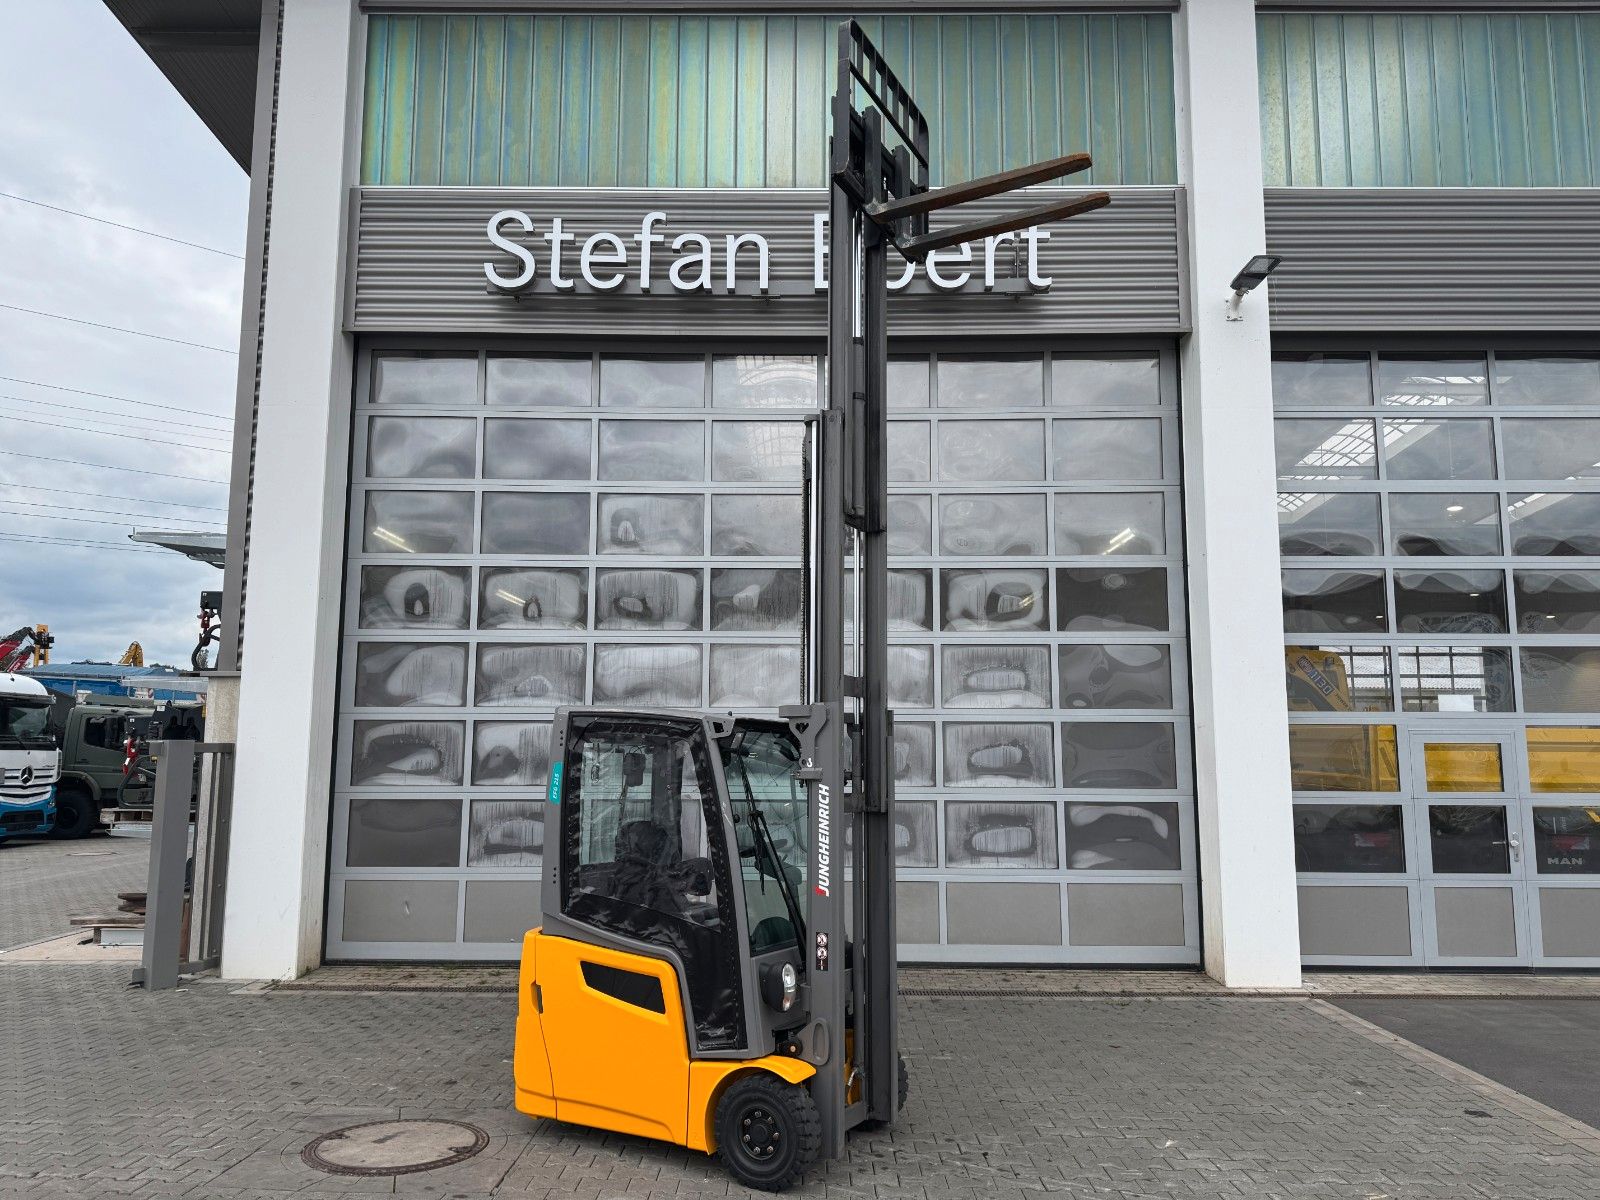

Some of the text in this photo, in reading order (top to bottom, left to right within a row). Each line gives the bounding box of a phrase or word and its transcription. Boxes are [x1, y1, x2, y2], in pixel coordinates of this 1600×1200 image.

[483, 209, 770, 292] Stefan
[815, 783, 830, 897] JUNGHEINRICH
[1547, 857, 1583, 865] MAN
